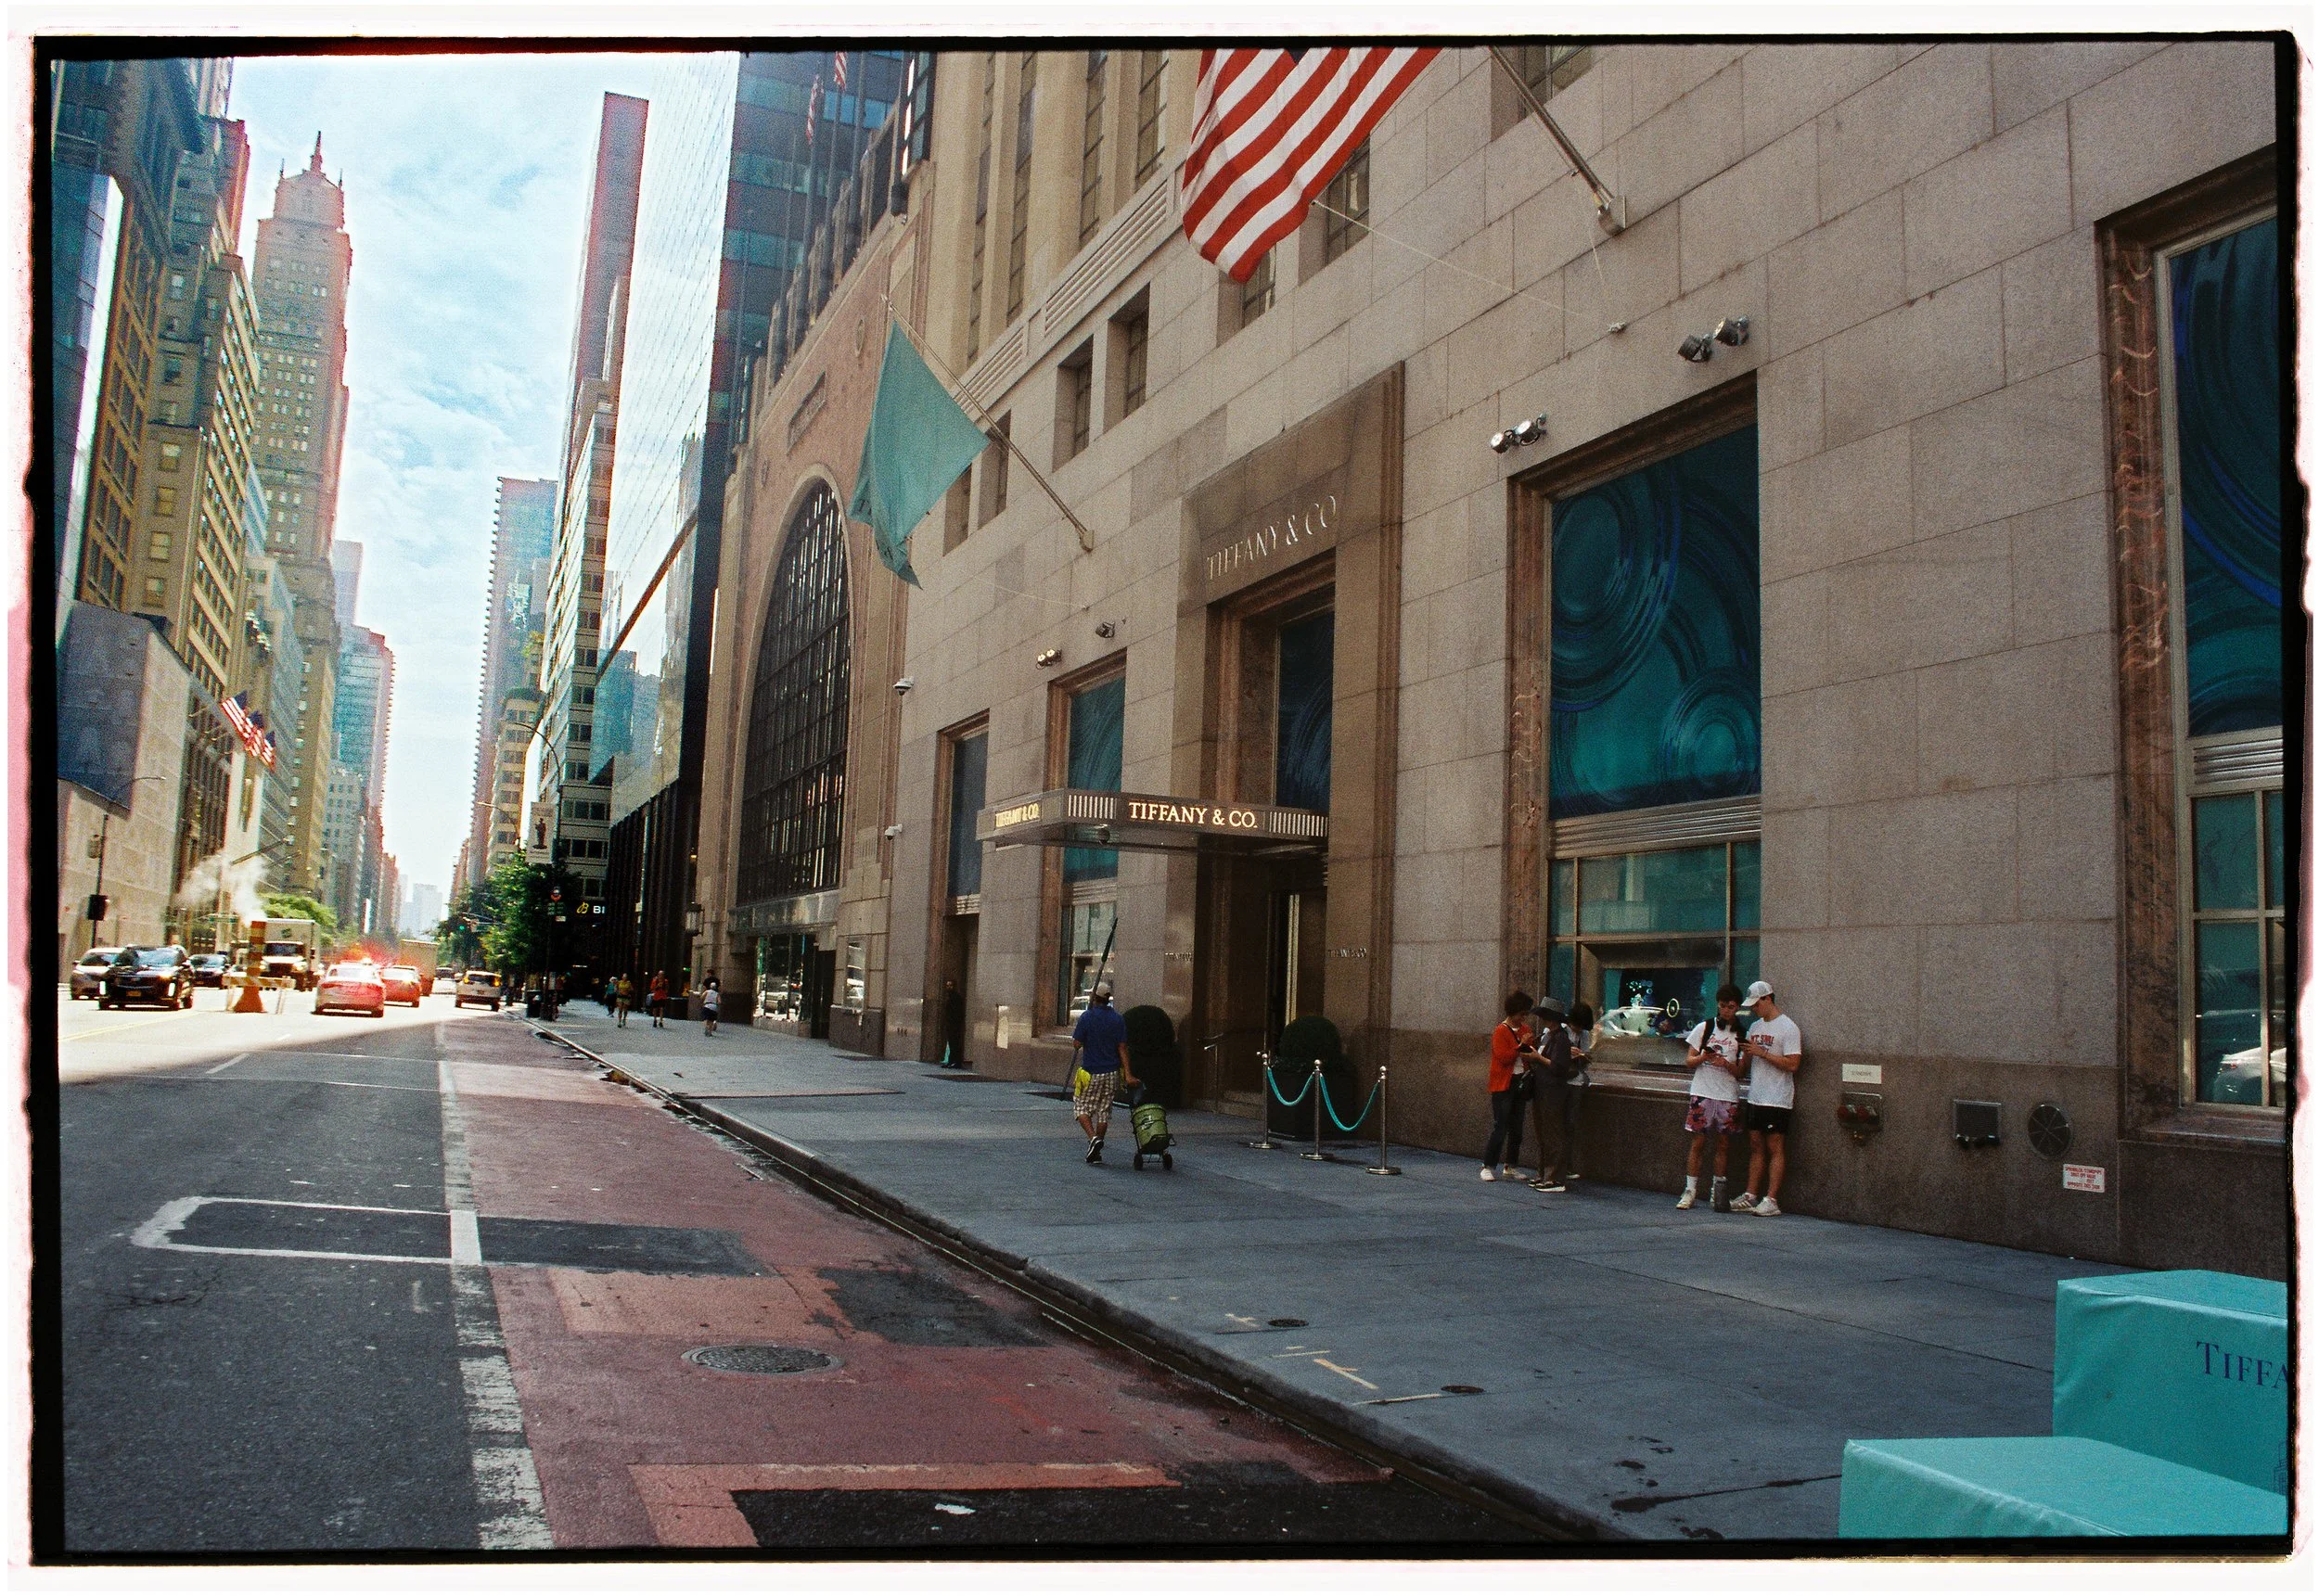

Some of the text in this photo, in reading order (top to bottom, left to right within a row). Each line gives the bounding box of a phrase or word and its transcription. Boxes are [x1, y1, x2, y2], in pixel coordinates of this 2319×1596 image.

[1207, 522, 1280, 580] TIFFANY
[1129, 801, 1258, 828] TIFFANY & CO.
